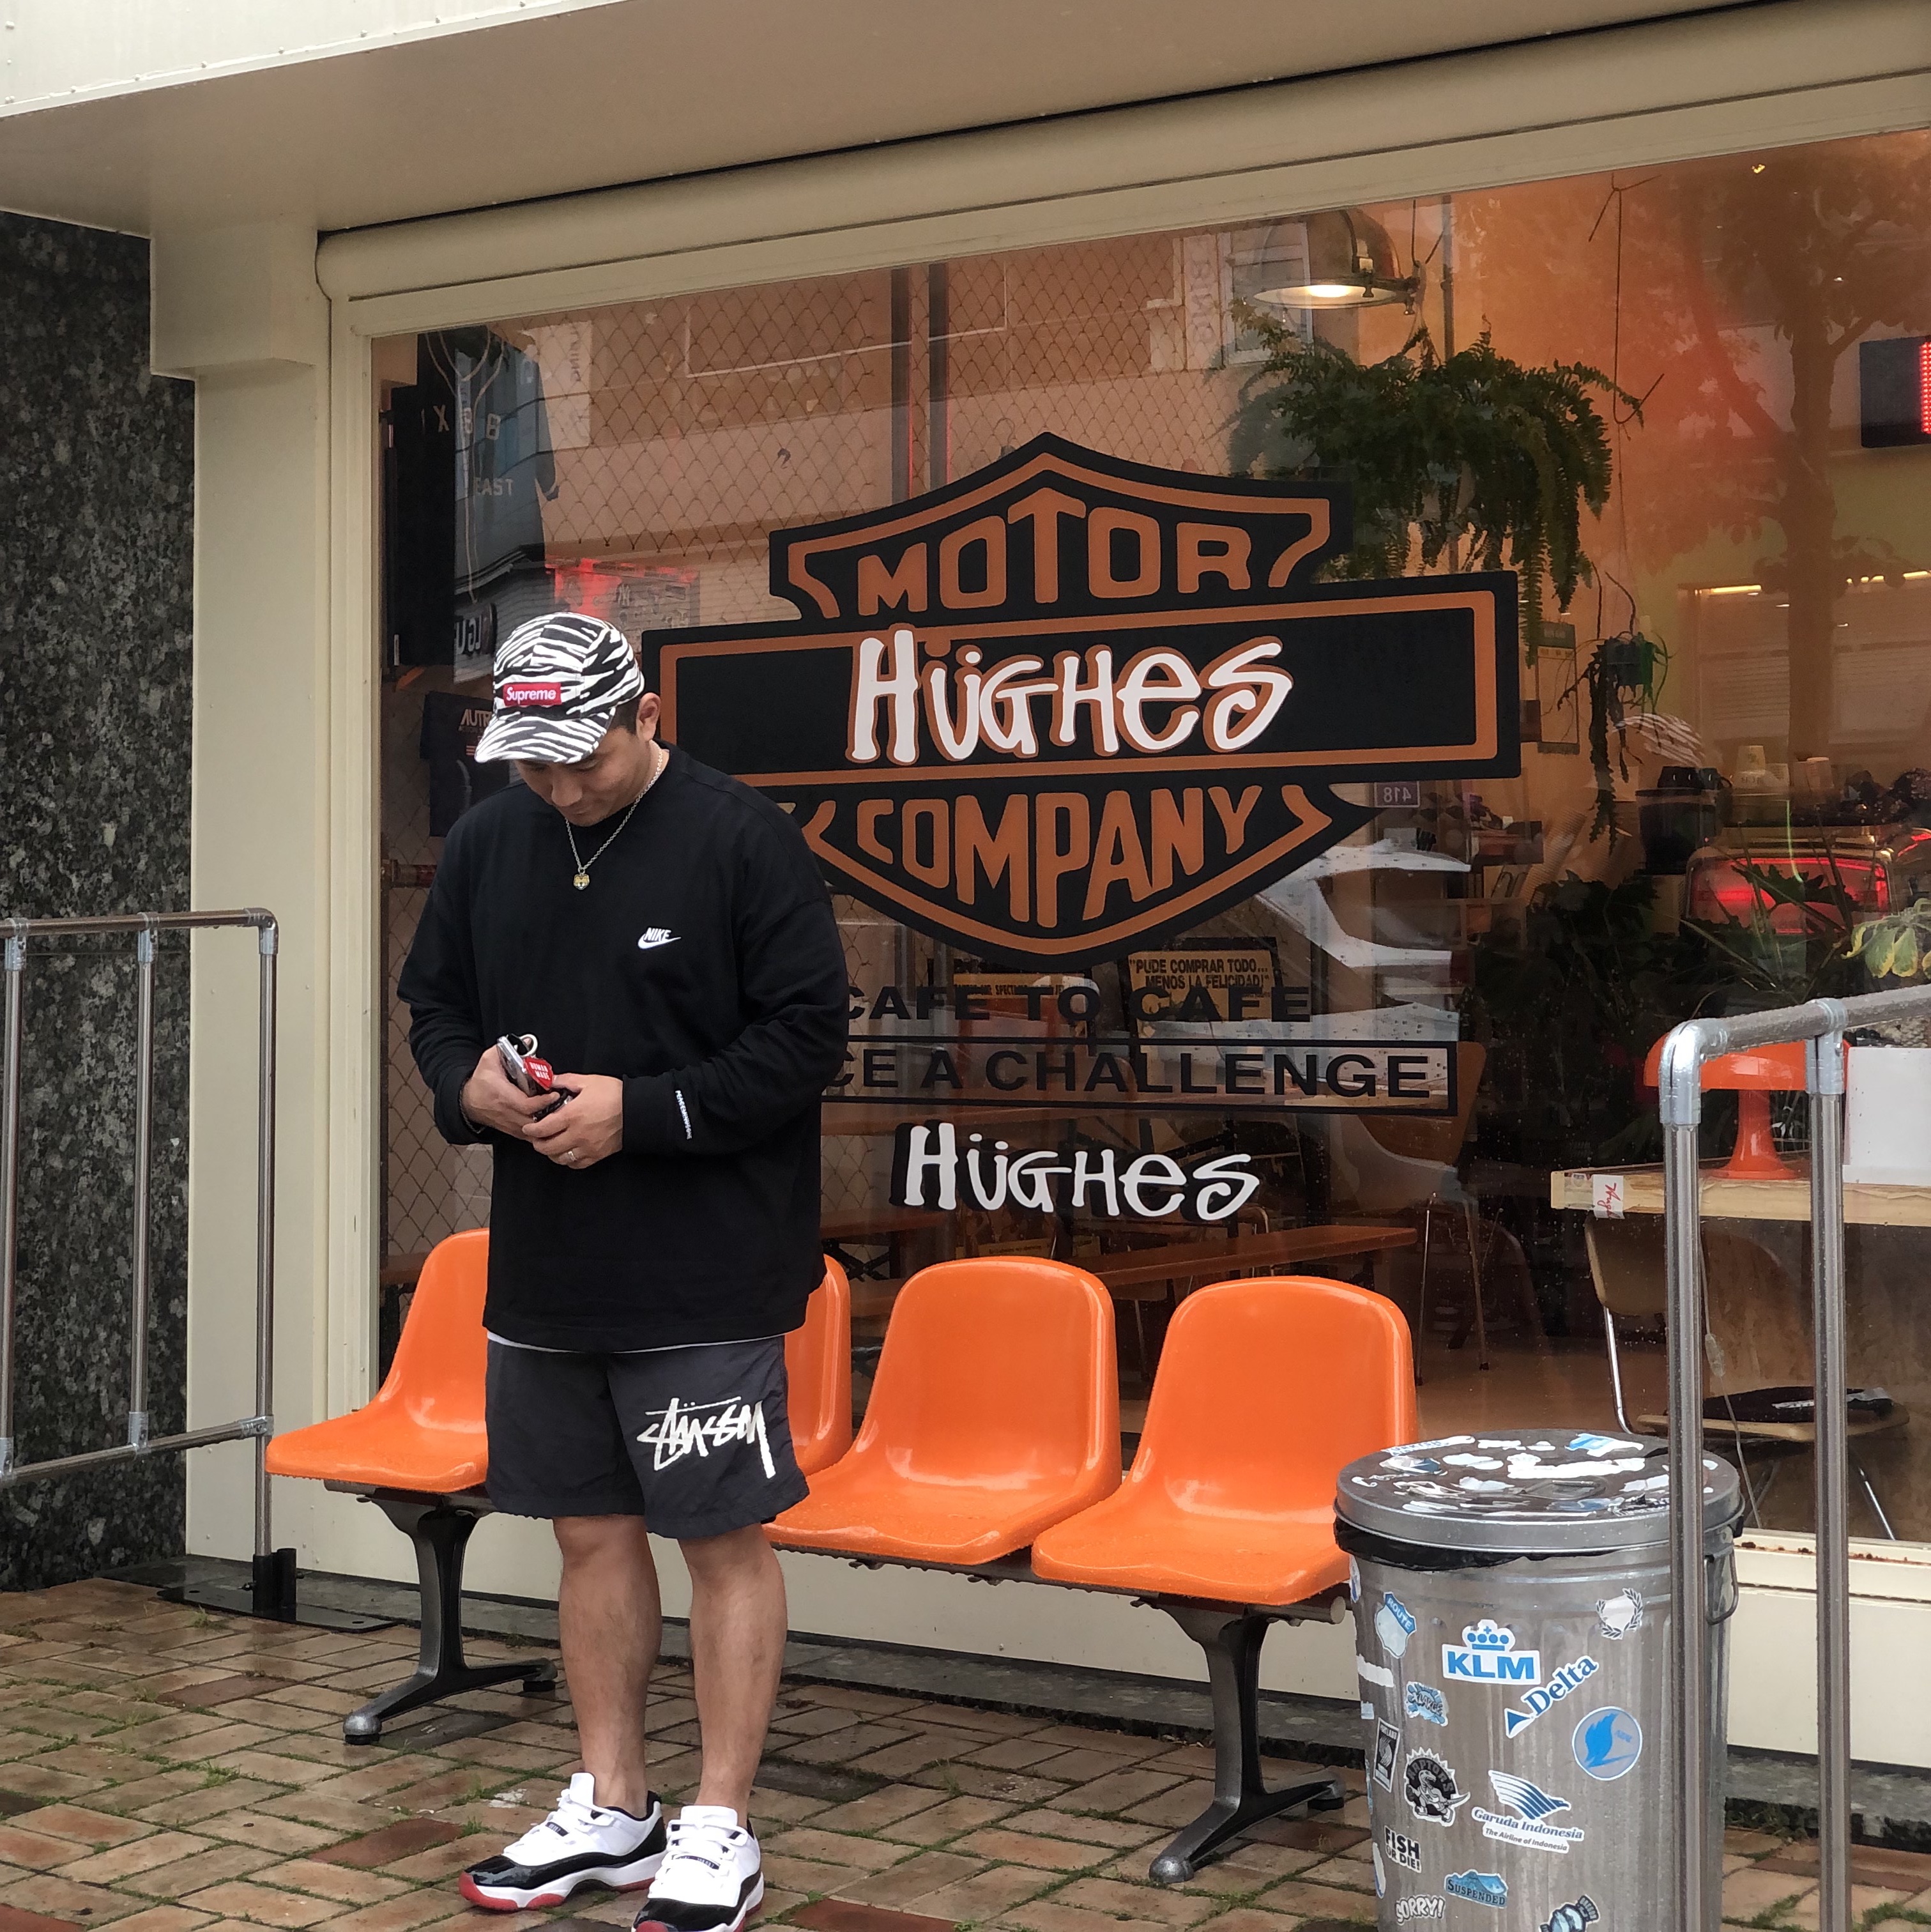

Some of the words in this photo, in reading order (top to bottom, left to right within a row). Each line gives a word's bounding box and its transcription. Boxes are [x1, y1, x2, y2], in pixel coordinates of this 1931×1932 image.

[857, 487, 1252, 616] MOTOR
[506, 687, 556, 704] Supreme
[857, 785, 1262, 928] COMPANY
[643, 927, 673, 942] NIKE
[1170, 959, 1225, 974] COMPRAR
[1145, 975, 1186, 990] MENOS
[1188, 976, 1203, 988] LA
[1014, 986, 1101, 1022] TO
[1129, 985, 1311, 1022] CAFE
[920, 1050, 963, 1089] A
[986, 1050, 1430, 1099] CHALLENGE
[1387, 1597, 1412, 1630] ROUTE
[1447, 1650, 1535, 1680] KLM
[1524, 1657, 1598, 1717] Delta
[1411, 1690, 1444, 1717] XLARGE
[1407, 1759, 1454, 1793] RAPTORS
[1474, 1809, 1518, 1829] Garuda
[1521, 1821, 1583, 1839] Indonesia
[1385, 1827, 1419, 1859] FISH
[1485, 1828, 1498, 1837] The
[1499, 1832, 1522, 1843] Airline
[1532, 1839, 1568, 1851] Indonesia
[1386, 1844, 1397, 1860] OR
[1400, 1853, 1420, 1871] DIE!
[1447, 1879, 1506, 1906] SUSPENDED
[1396, 1895, 1446, 1924] SORRY!
